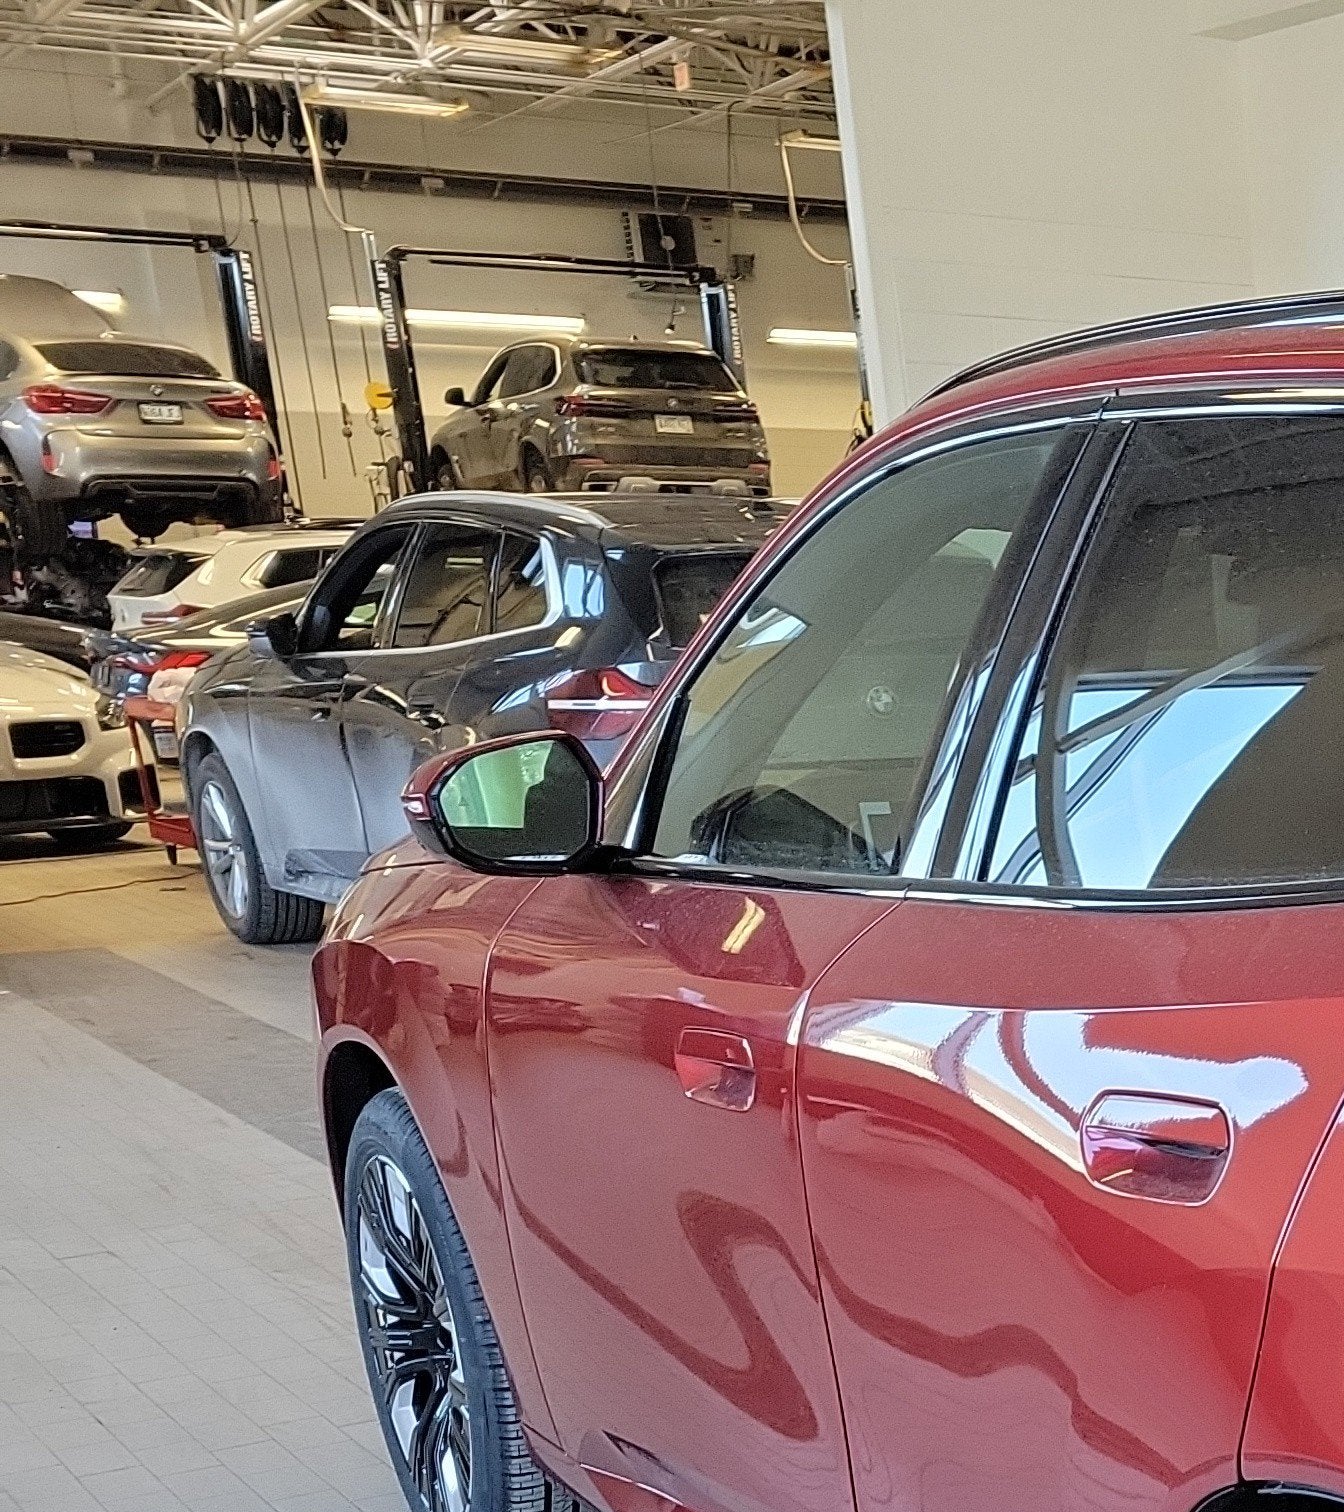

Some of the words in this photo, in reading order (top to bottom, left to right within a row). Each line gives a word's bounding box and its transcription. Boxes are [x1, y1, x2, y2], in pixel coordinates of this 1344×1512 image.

[239, 251, 252, 280] LIFT
[374, 260, 390, 289] LIFT
[244, 282, 262, 335] ROTARY
[379, 291, 399, 342] ROTARY
